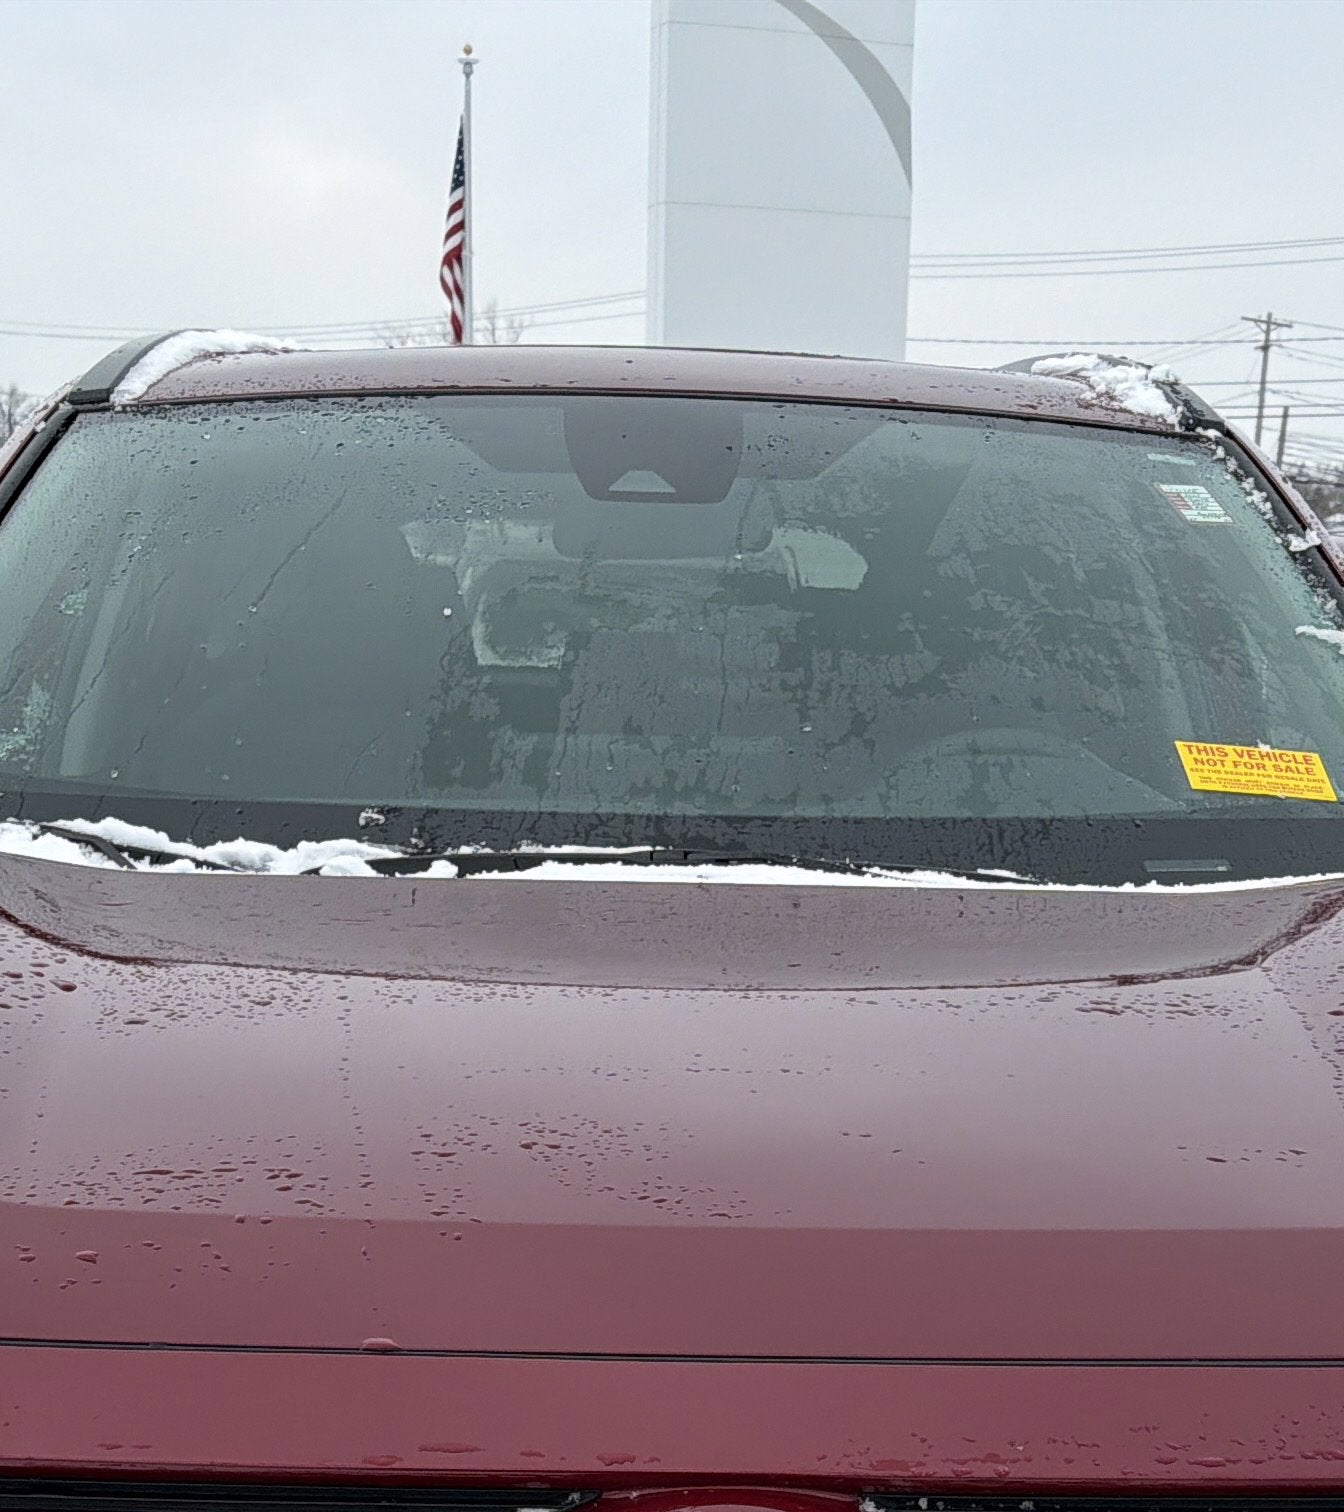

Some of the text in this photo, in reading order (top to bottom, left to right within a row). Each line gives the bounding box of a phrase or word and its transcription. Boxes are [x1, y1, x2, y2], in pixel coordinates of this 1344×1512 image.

[1183, 743, 1316, 766] THIS VEHICLE
[1193, 757, 1317, 776] NOT FOR SALE
[1224, 769, 1256, 777] DEALER
[1274, 773, 1305, 782] RESALE
